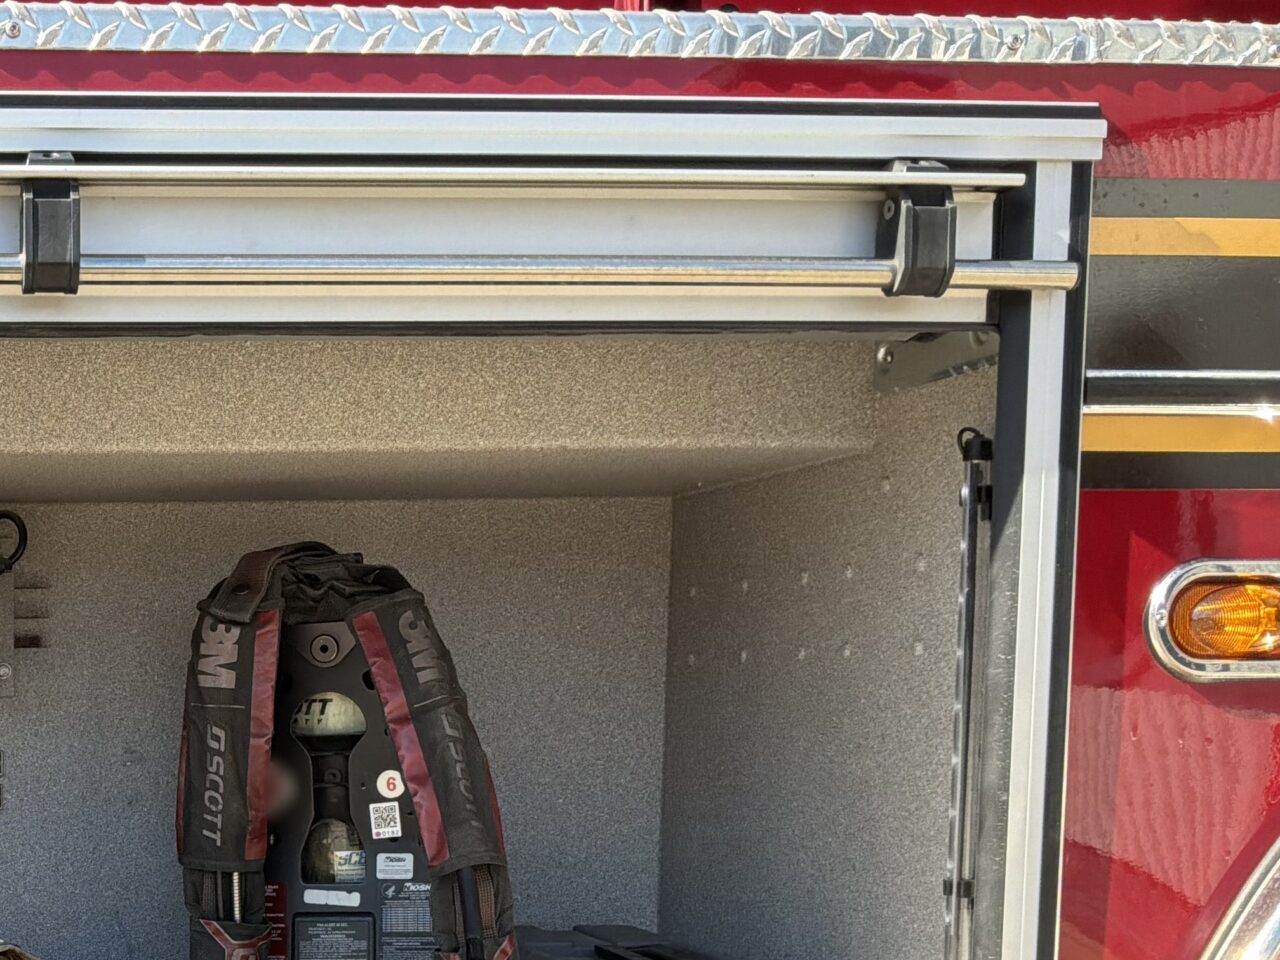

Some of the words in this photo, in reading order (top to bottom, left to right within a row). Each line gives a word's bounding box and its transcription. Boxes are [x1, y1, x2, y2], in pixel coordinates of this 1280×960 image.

[197, 614, 241, 689] 3M
[202, 754, 225, 847] SCOTT
[386, 776, 397, 792] 6
